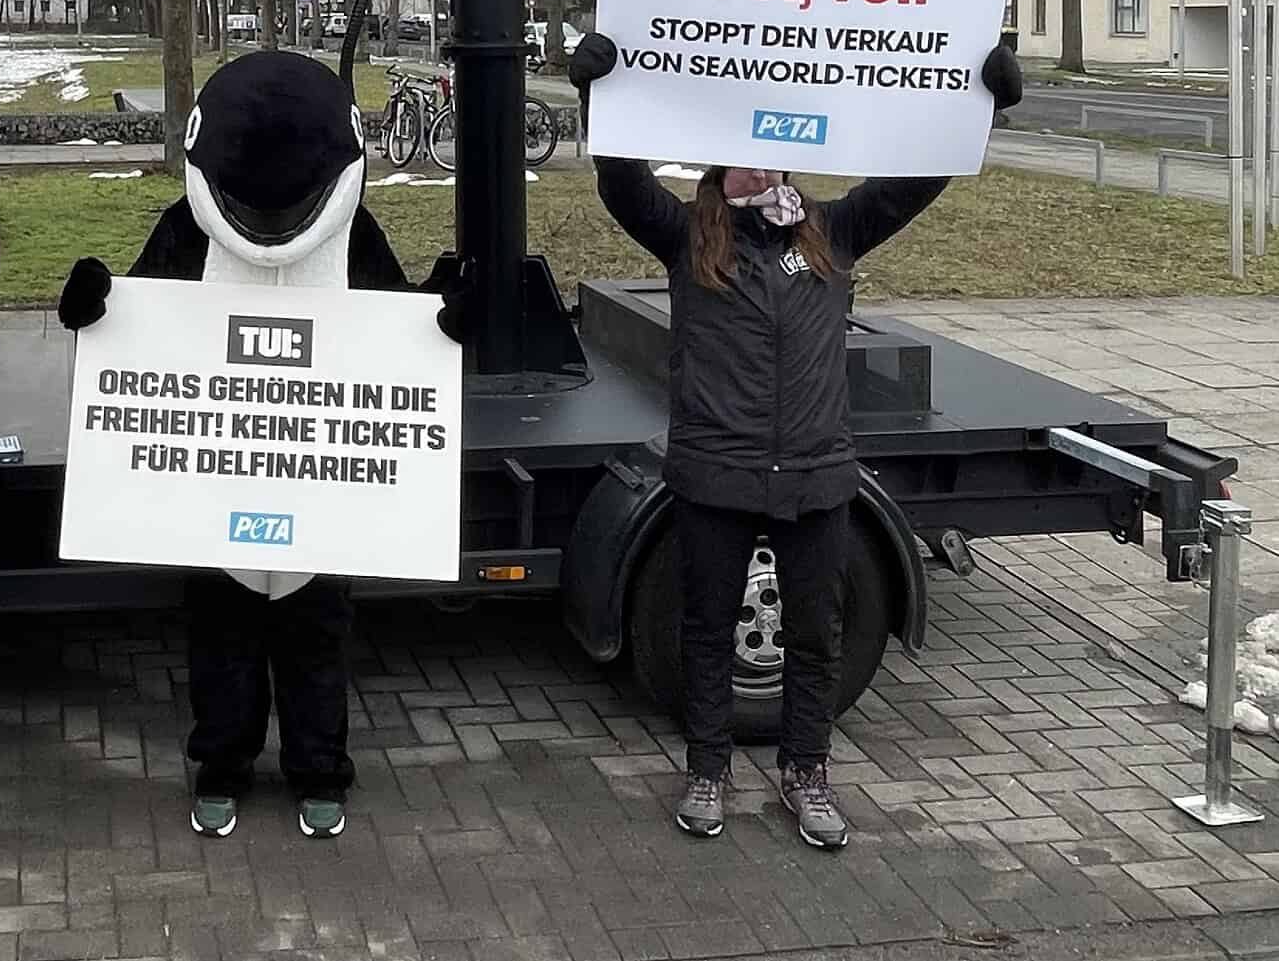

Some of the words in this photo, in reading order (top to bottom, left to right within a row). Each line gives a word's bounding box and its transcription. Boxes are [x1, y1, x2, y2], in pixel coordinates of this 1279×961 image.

[649, 17, 756, 46] STOPPT
[760, 24, 818, 49] DEN
[824, 27, 949, 54] VERKAUF
[620, 47, 683, 74] VON
[688, 54, 971, 91] SEAWORLD-TICKETS!
[98, 369, 201, 400] ORCAS
[208, 375, 345, 408] GEHÖREN
[352, 383, 383, 410] IN
[391, 385, 437, 413] DIE
[85, 404, 224, 438] FREIHEIT!
[231, 413, 317, 443] KEINE
[323, 418, 446, 451] TICKETS
[131, 443, 189, 473] FÜR
[196, 447, 398, 485] DELFINARIEN!
